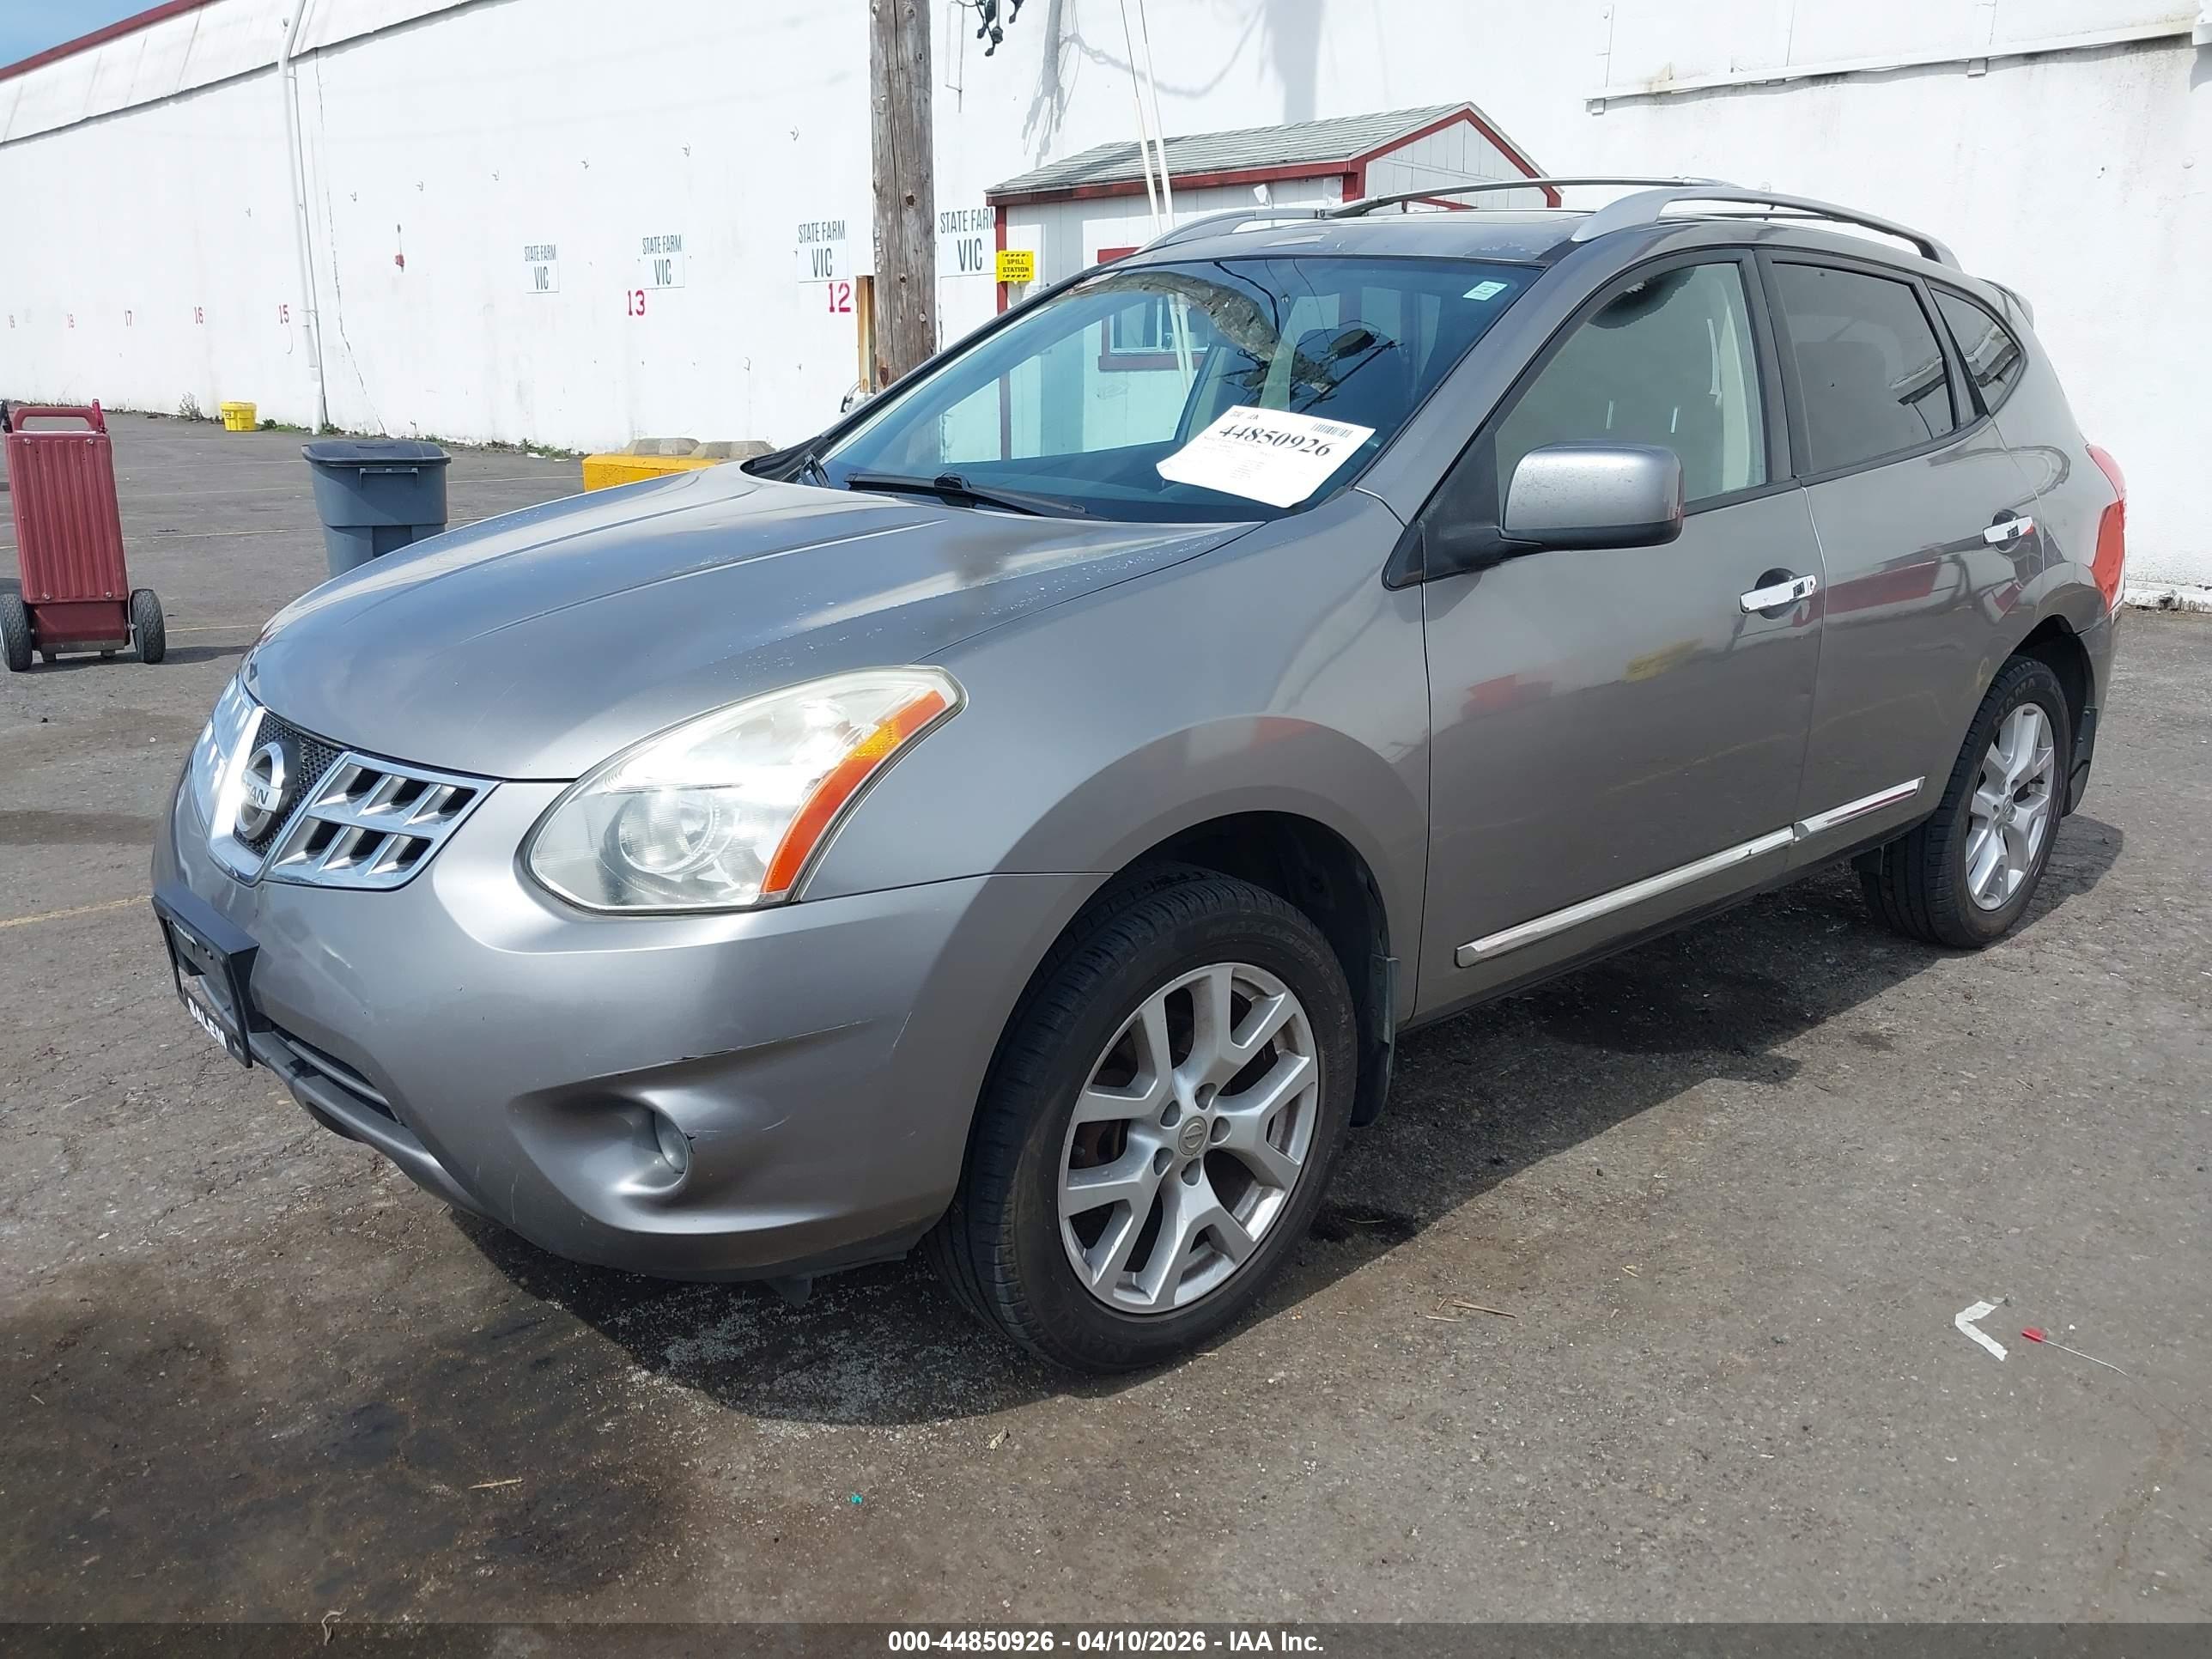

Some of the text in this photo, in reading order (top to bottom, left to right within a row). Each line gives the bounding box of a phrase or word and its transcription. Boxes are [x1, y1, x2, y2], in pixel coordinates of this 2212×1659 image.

[798, 220, 846, 244] STATE FARM
[940, 210, 968, 234] STATE
[524, 244, 556, 262] STATE FARM
[642, 234, 682, 255] STATE FARM
[957, 238, 982, 271] VIC
[654, 258, 672, 285] VIC
[812, 247, 833, 277] VIC
[534, 265, 549, 290] VIC
[628, 290, 646, 316] 13
[829, 283, 851, 313] 12
[67, 313, 75, 328] 18
[125, 310, 132, 327] 17
[194, 307, 204, 324] 16
[278, 304, 289, 324] 15
[1219, 423, 1337, 458] 44850926
[187, 996, 228, 1051] SALEM
